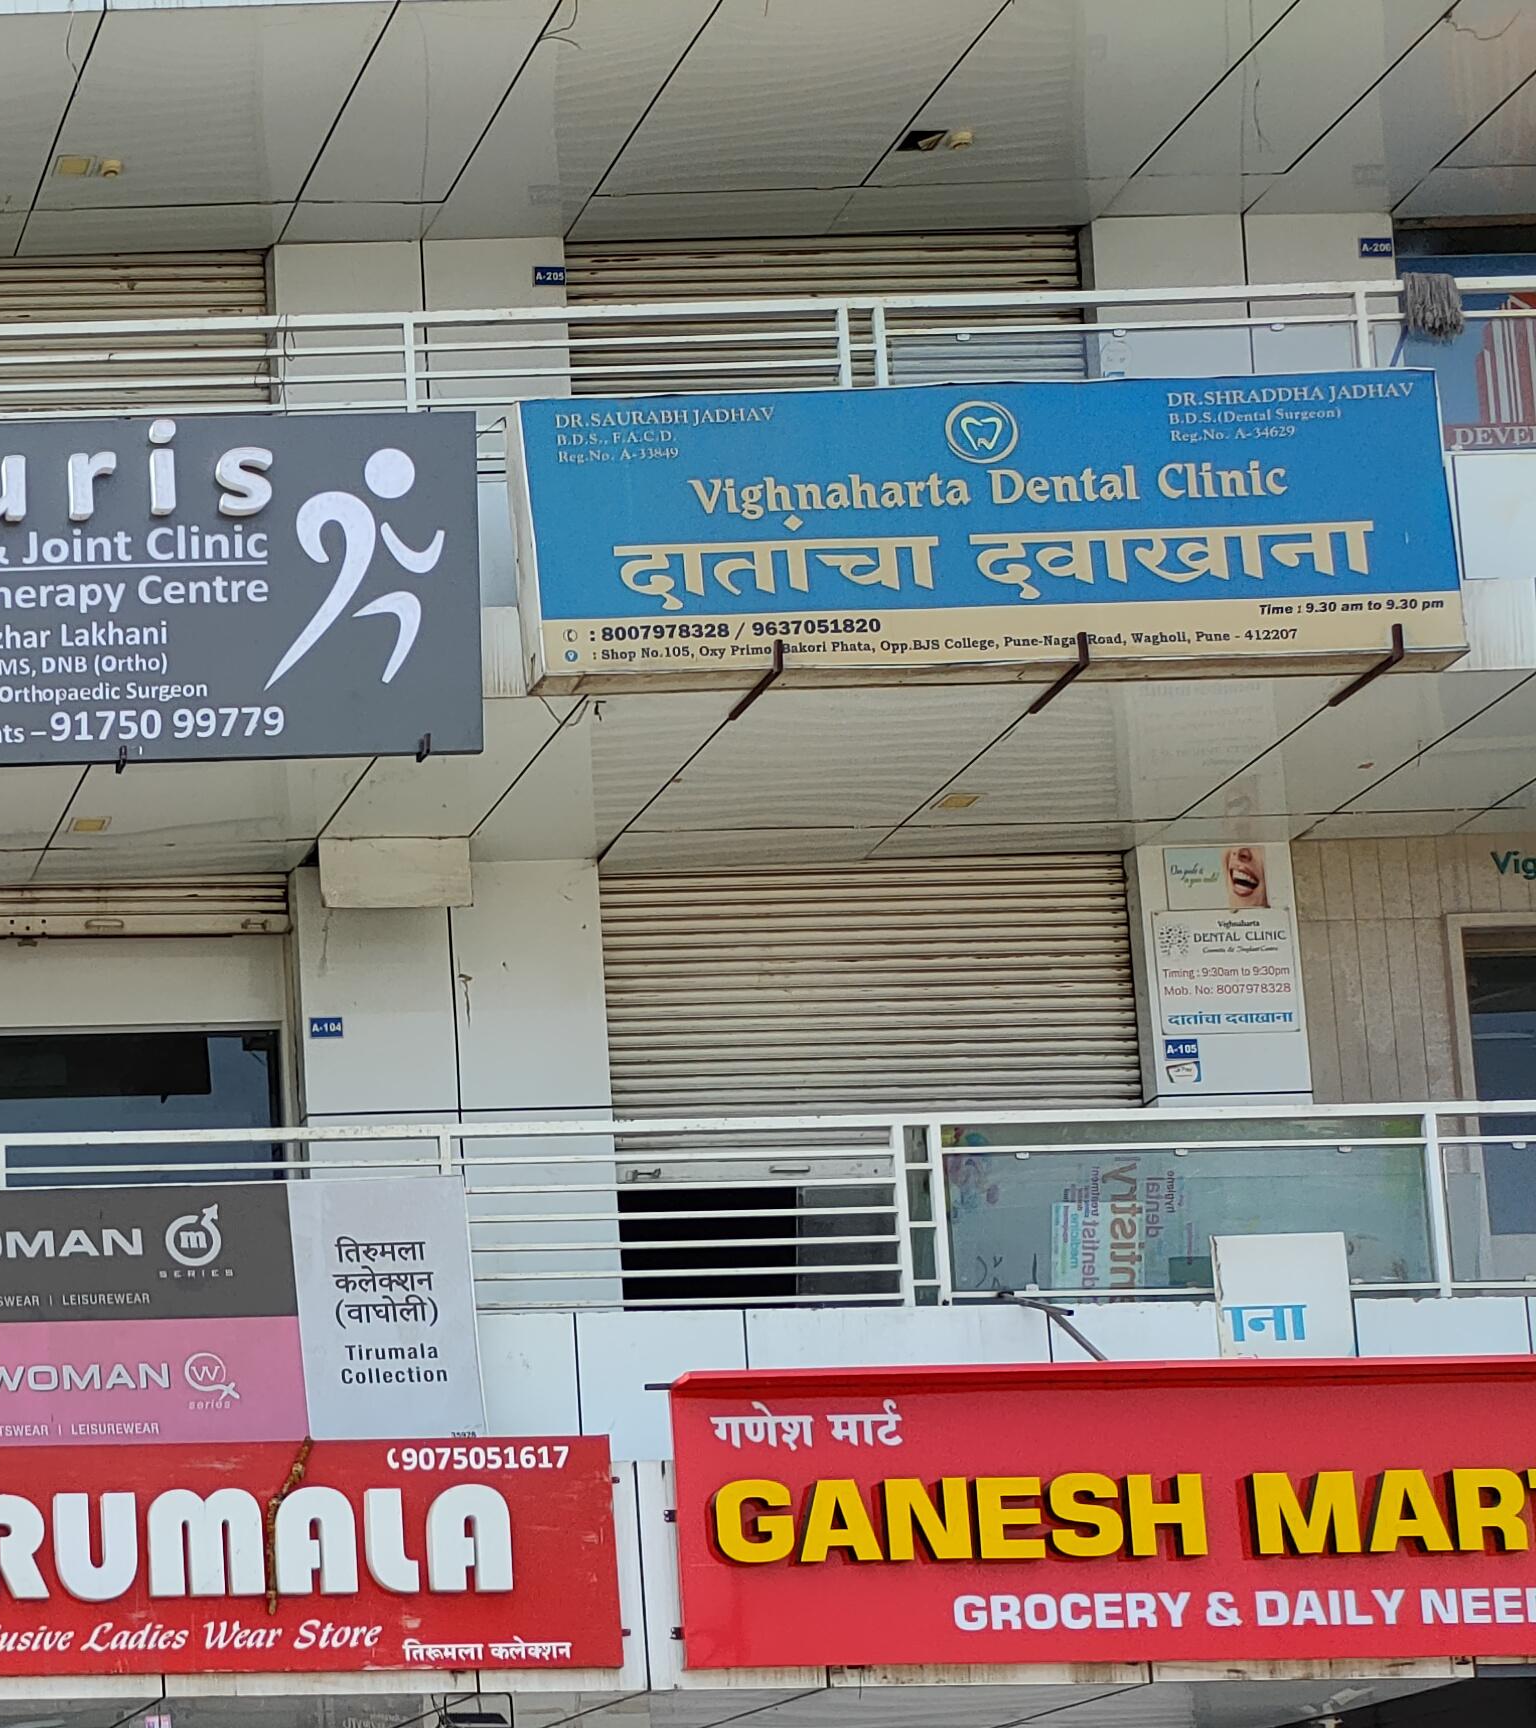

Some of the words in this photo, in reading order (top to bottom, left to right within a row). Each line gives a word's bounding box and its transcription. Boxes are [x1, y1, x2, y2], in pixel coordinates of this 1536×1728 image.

[1328, 382, 1414, 403] JADHAV
[692, 407, 776, 427] JADHAV
[1234, 425, 1296, 439] A-34629
[688, 474, 971, 521] Vighnaharta
[990, 465, 1138, 506] Dental
[1156, 461, 1289, 502] Clinic
[23, 528, 136, 566] Joint
[146, 526, 268, 561] Clinic
[613, 516, 938, 610] दातांचा
[969, 519, 1374, 599] दवाखाना
[136, 573, 270, 606] Centre
[59, 622, 169, 647] Lakhani
[601, 622, 730, 643] 8007978328
[751, 617, 882, 638] 9637051820
[1193, 930, 1241, 943] DENTAL
[1245, 929, 1287, 941] CLINIC
[1164, 985, 1192, 996] Mob.
[1216, 983, 1291, 994] 8007978328
[310, 1022, 342, 1034] A-104
[1225, 1011, 1293, 1024] दवाखाना
[1166, 1044, 1198, 1054] A-105
[334, 1235, 427, 1264] तिरुमला
[332, 1265, 435, 1294] कलेक्शन
[62, 1291, 151, 1307] LEISUREWEAR
[335, 1294, 439, 1329] (वाघोली)
[344, 1342, 440, 1362] Tirumala
[340, 1365, 449, 1386] Collection
[710, 1402, 815, 1452] गणेश
[827, 1399, 904, 1446] मार्ट
[401, 1445, 570, 1472] 9075051617
[714, 1472, 1209, 1567] GANESH
[954, 1592, 1191, 1631] GROCERY
[1206, 1591, 1244, 1626] &
[1256, 1590, 1406, 1625] DAILY
[80, 1621, 188, 1653] Ladies
[203, 1621, 284, 1649] Wear
[294, 1618, 382, 1648] Store
